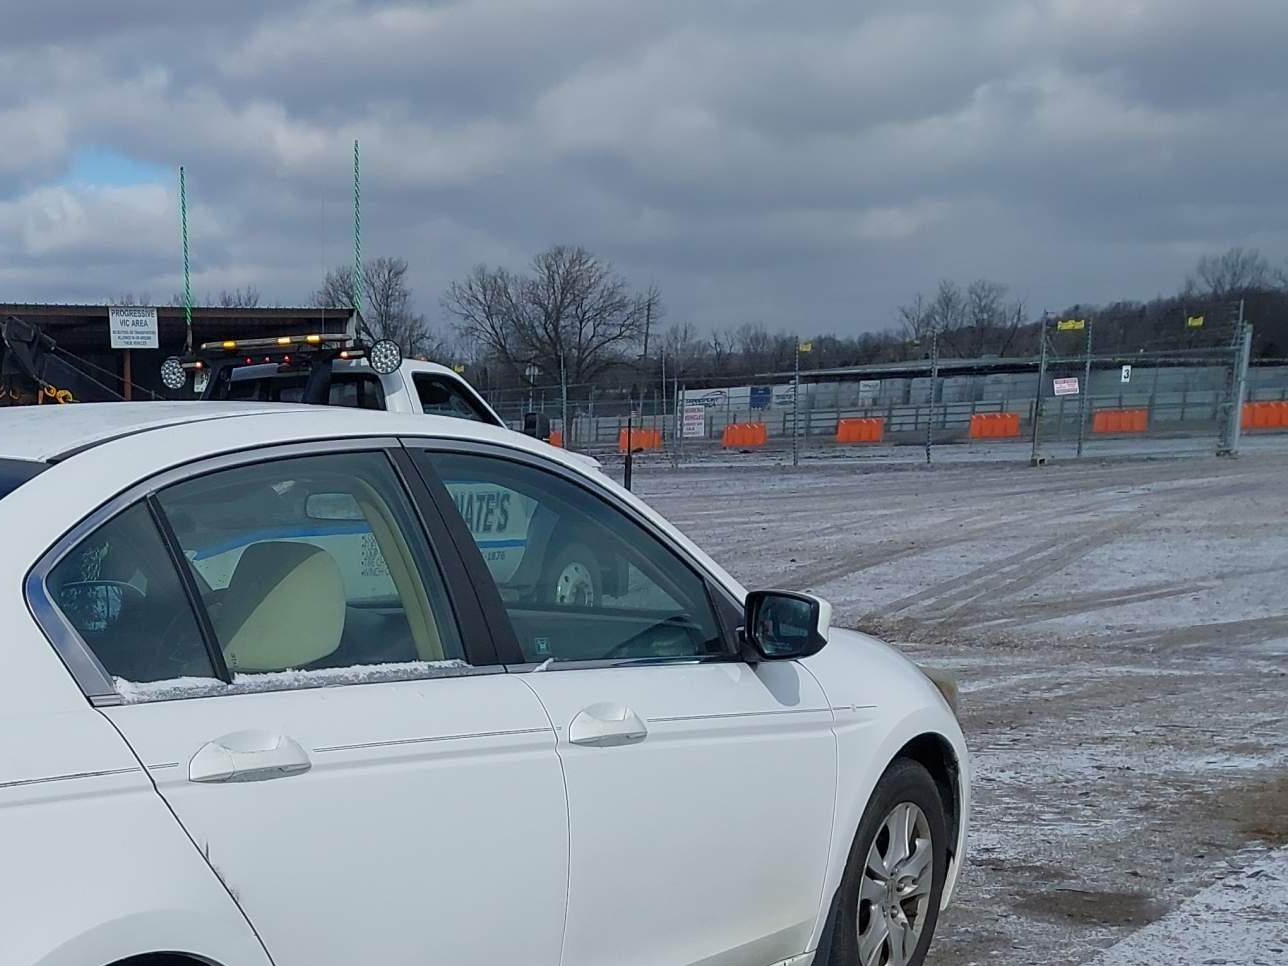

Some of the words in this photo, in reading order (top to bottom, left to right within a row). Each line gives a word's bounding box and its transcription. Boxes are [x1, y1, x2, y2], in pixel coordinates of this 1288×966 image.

[111, 309, 155, 318] PROGRESSIVE
[119, 319, 130, 327] VIC
[131, 319, 149, 328] AREA
[1123, 369, 1130, 379] 3
